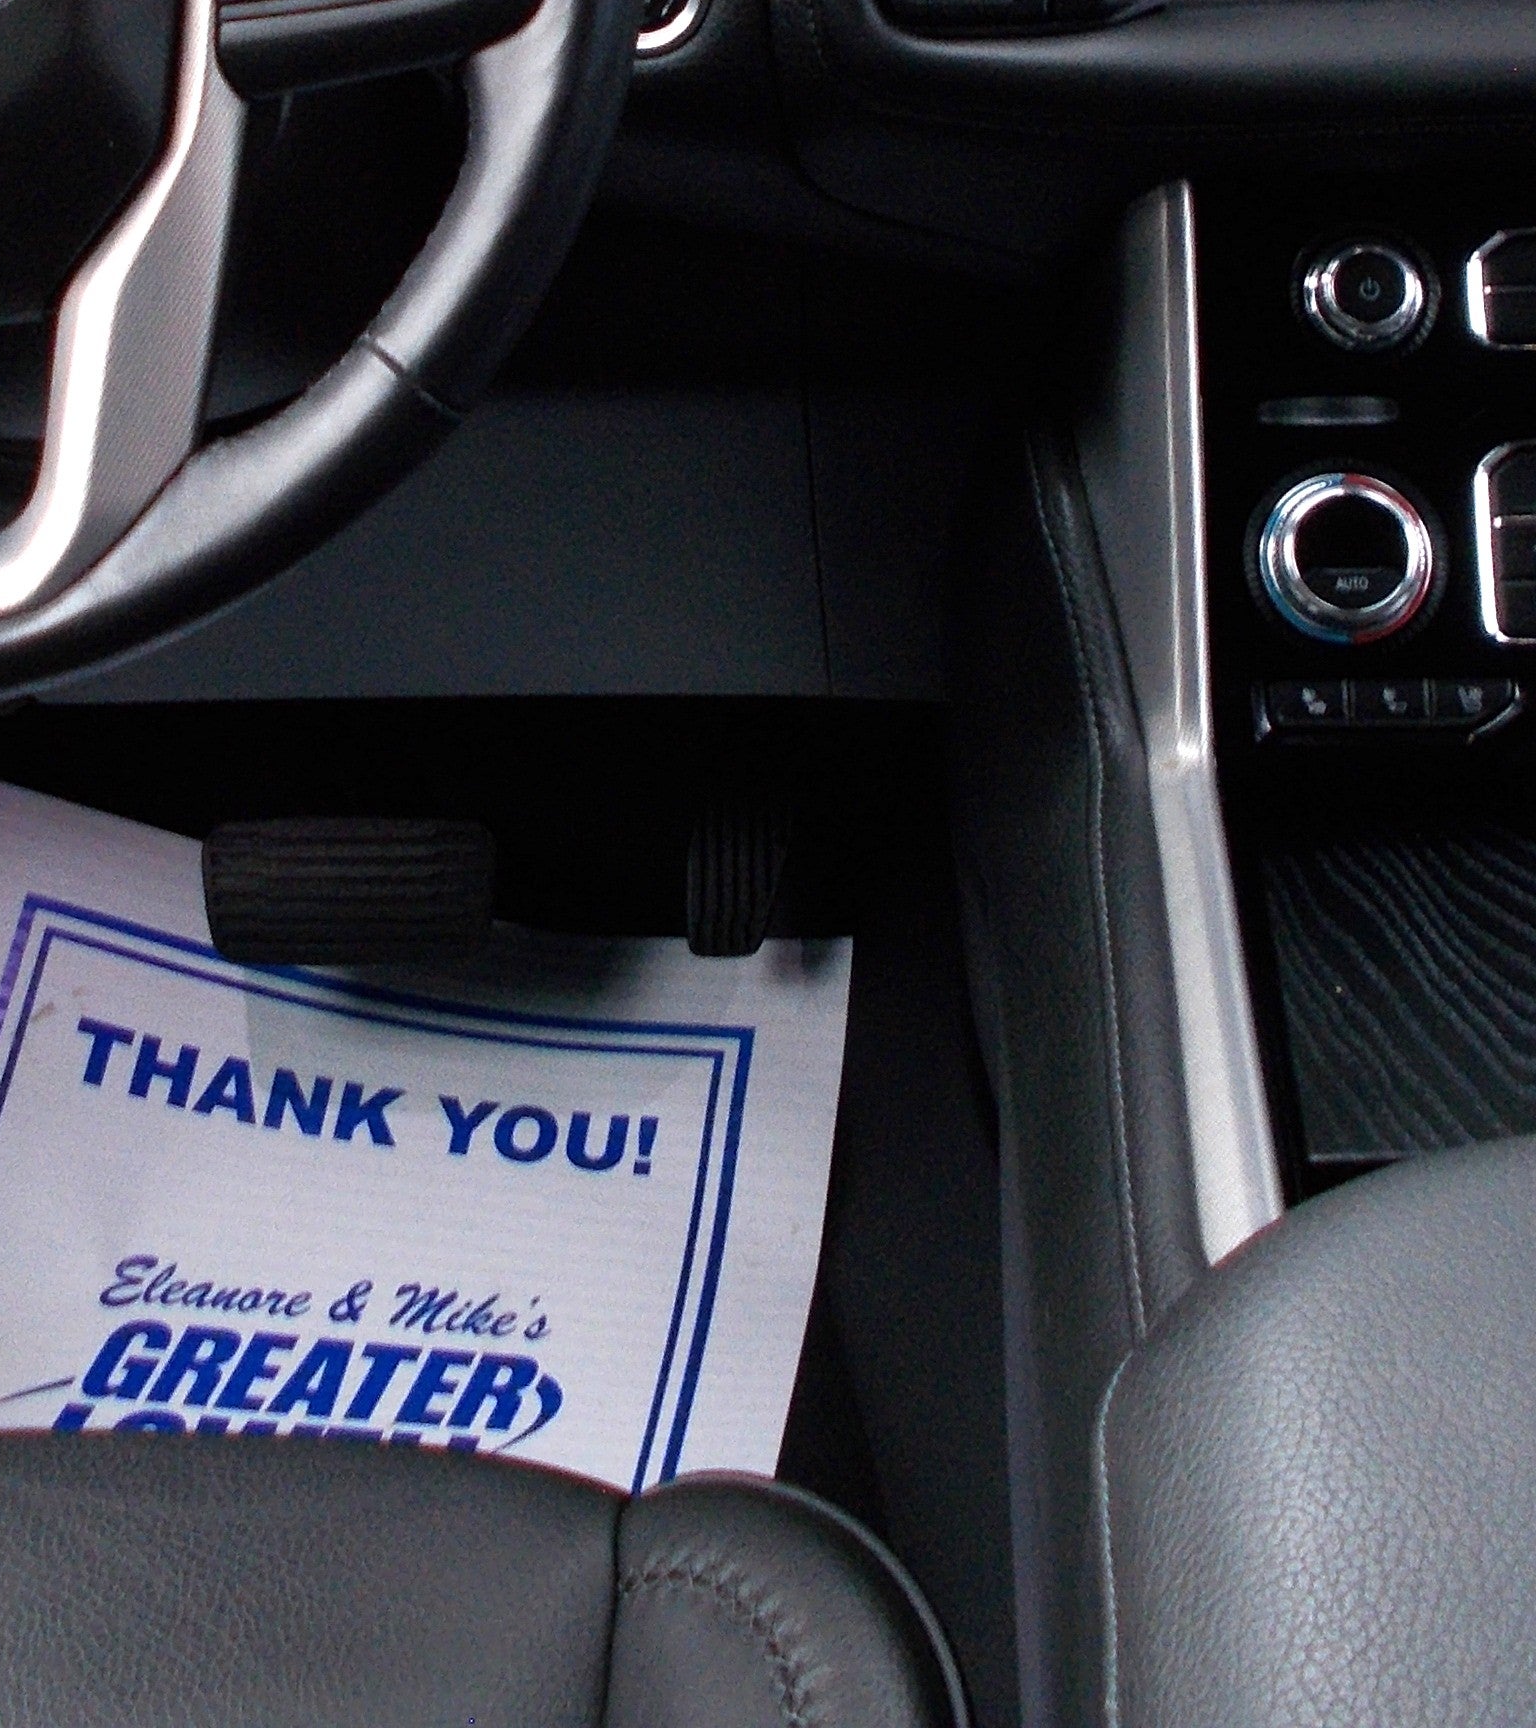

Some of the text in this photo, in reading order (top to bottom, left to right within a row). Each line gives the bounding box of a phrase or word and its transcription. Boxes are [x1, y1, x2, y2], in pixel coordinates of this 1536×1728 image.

[1335, 575, 1369, 591] AUTO
[76, 1017, 659, 1176] THANK YOU!
[98, 1253, 552, 1342] Eleanore & Mike's
[79, 1317, 541, 1433] GREATER
